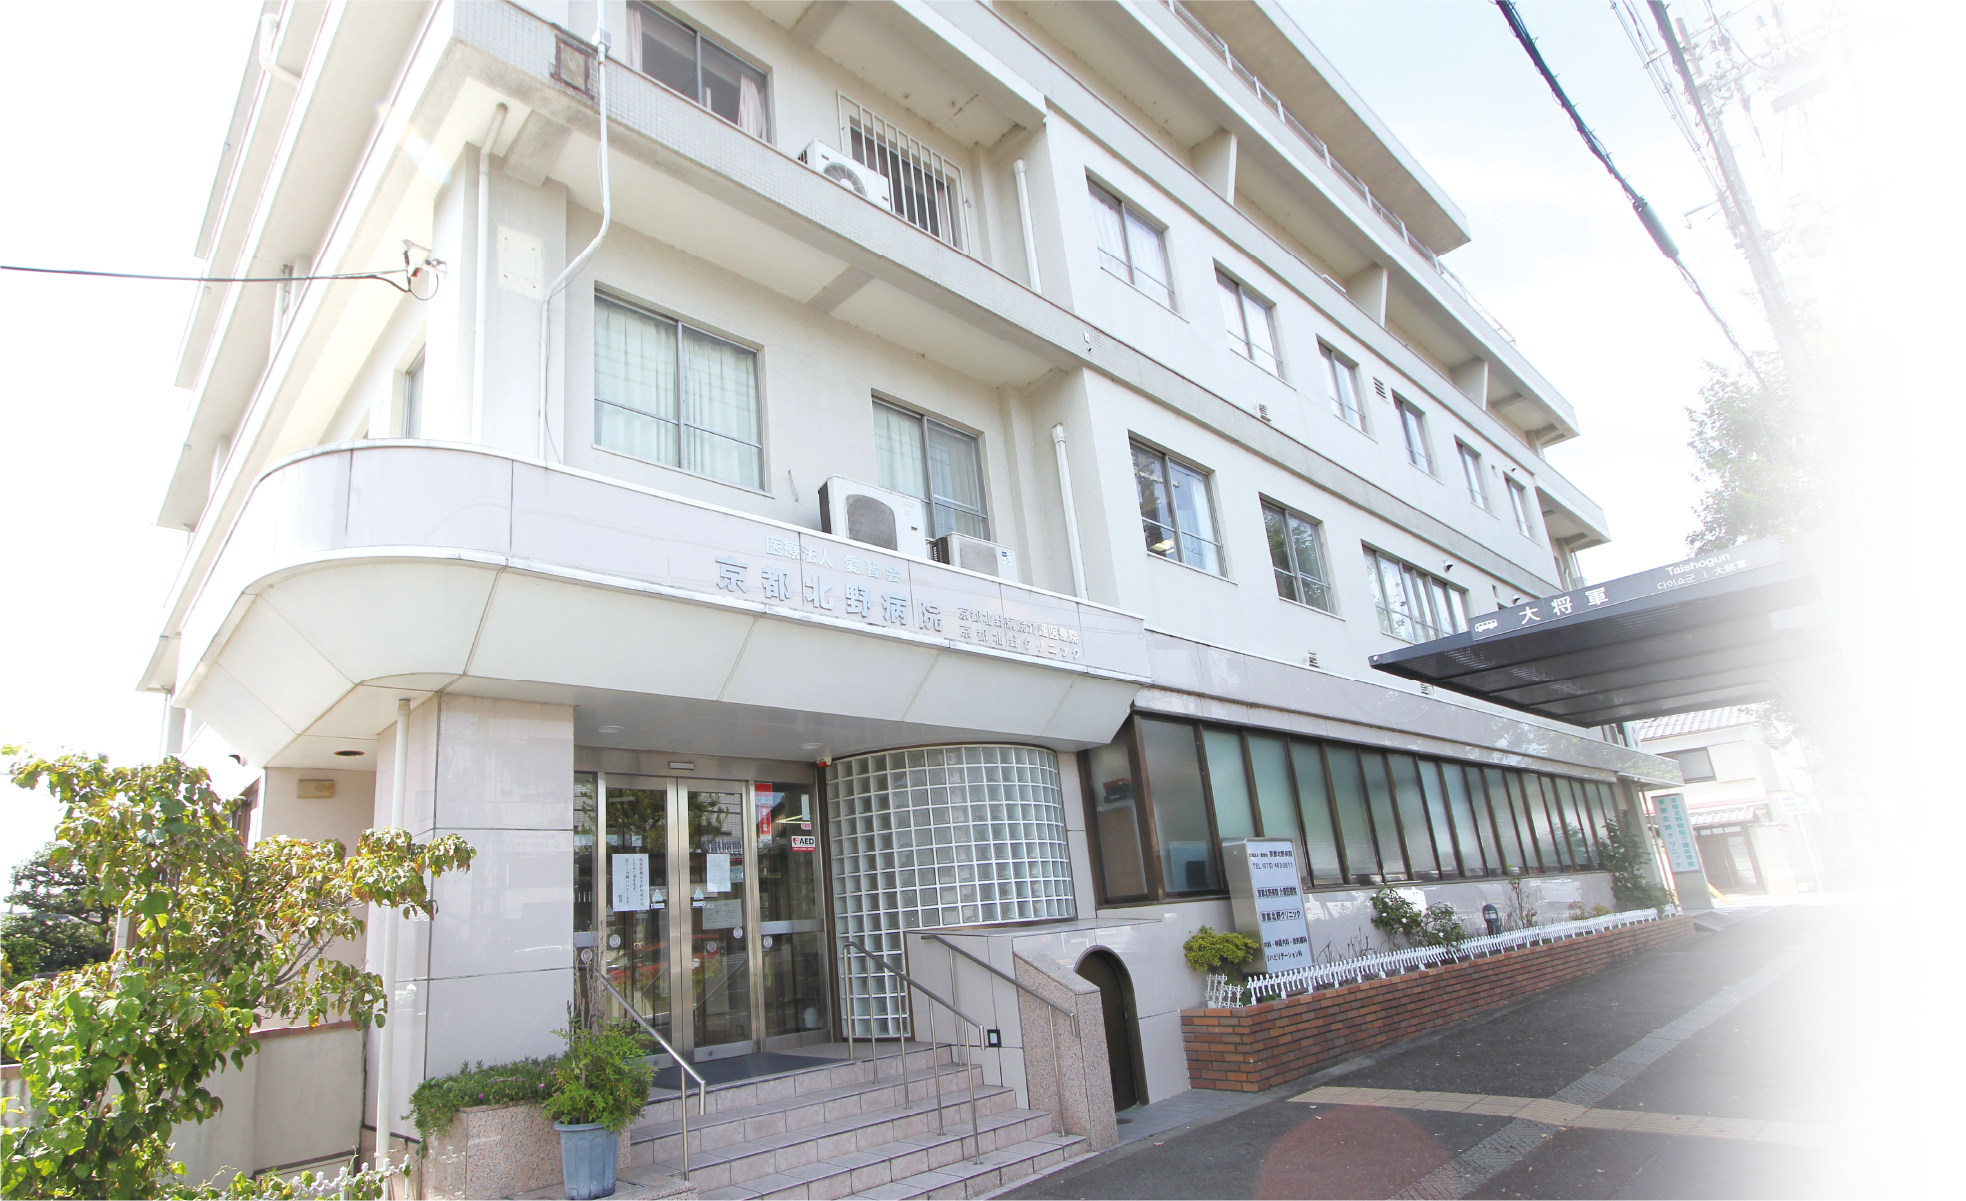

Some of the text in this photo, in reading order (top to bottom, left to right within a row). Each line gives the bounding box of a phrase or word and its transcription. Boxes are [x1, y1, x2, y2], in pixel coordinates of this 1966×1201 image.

[765, 534, 900, 583] 医療法人 愛智会
[1665, 553, 1731, 576] Taishogun
[715, 555, 943, 632] 京都北野病院
[1657, 574, 1696, 590] 다이쇼군
[1518, 587, 1609, 625] 大将軍
[958, 607, 1079, 644] 京都北野病院介護医療院
[960, 626, 1080, 659] 京都北野クリニック
[1657, 798, 1682, 869] 京都北野クリニック
[1670, 797, 1696, 867] 京都北野病院介護医療院
[1252, 862, 1261, 870] TEL
[1261, 909, 1301, 922] 京都北野クリニック
